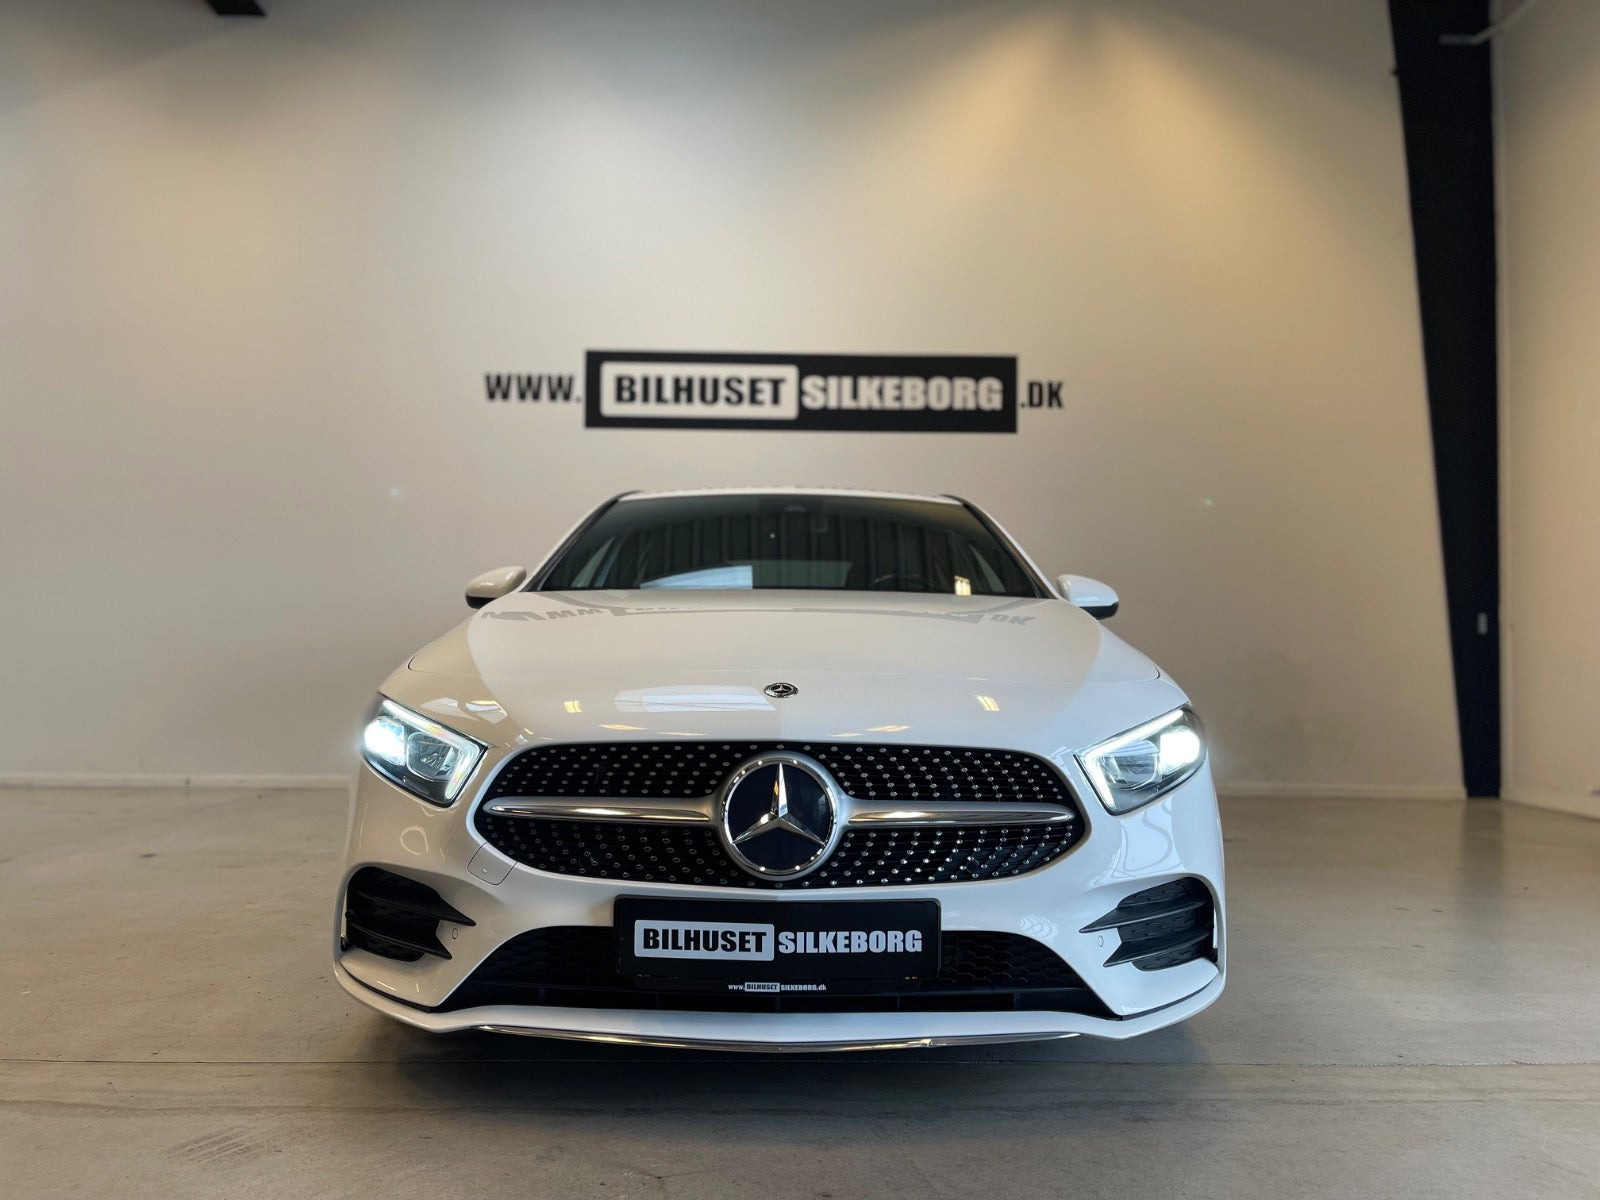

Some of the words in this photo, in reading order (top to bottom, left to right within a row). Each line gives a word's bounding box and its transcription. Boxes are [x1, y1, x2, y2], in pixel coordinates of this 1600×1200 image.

[485, 373, 581, 403] WWW.
[614, 375, 786, 406] BILHUSET
[801, 375, 1004, 411] SILKEBORG
[1020, 380, 1065, 408] .DK
[642, 927, 767, 953] BILHUSET
[778, 929, 923, 954] SILKEBORG
[746, 983, 778, 991] BILHUSET
